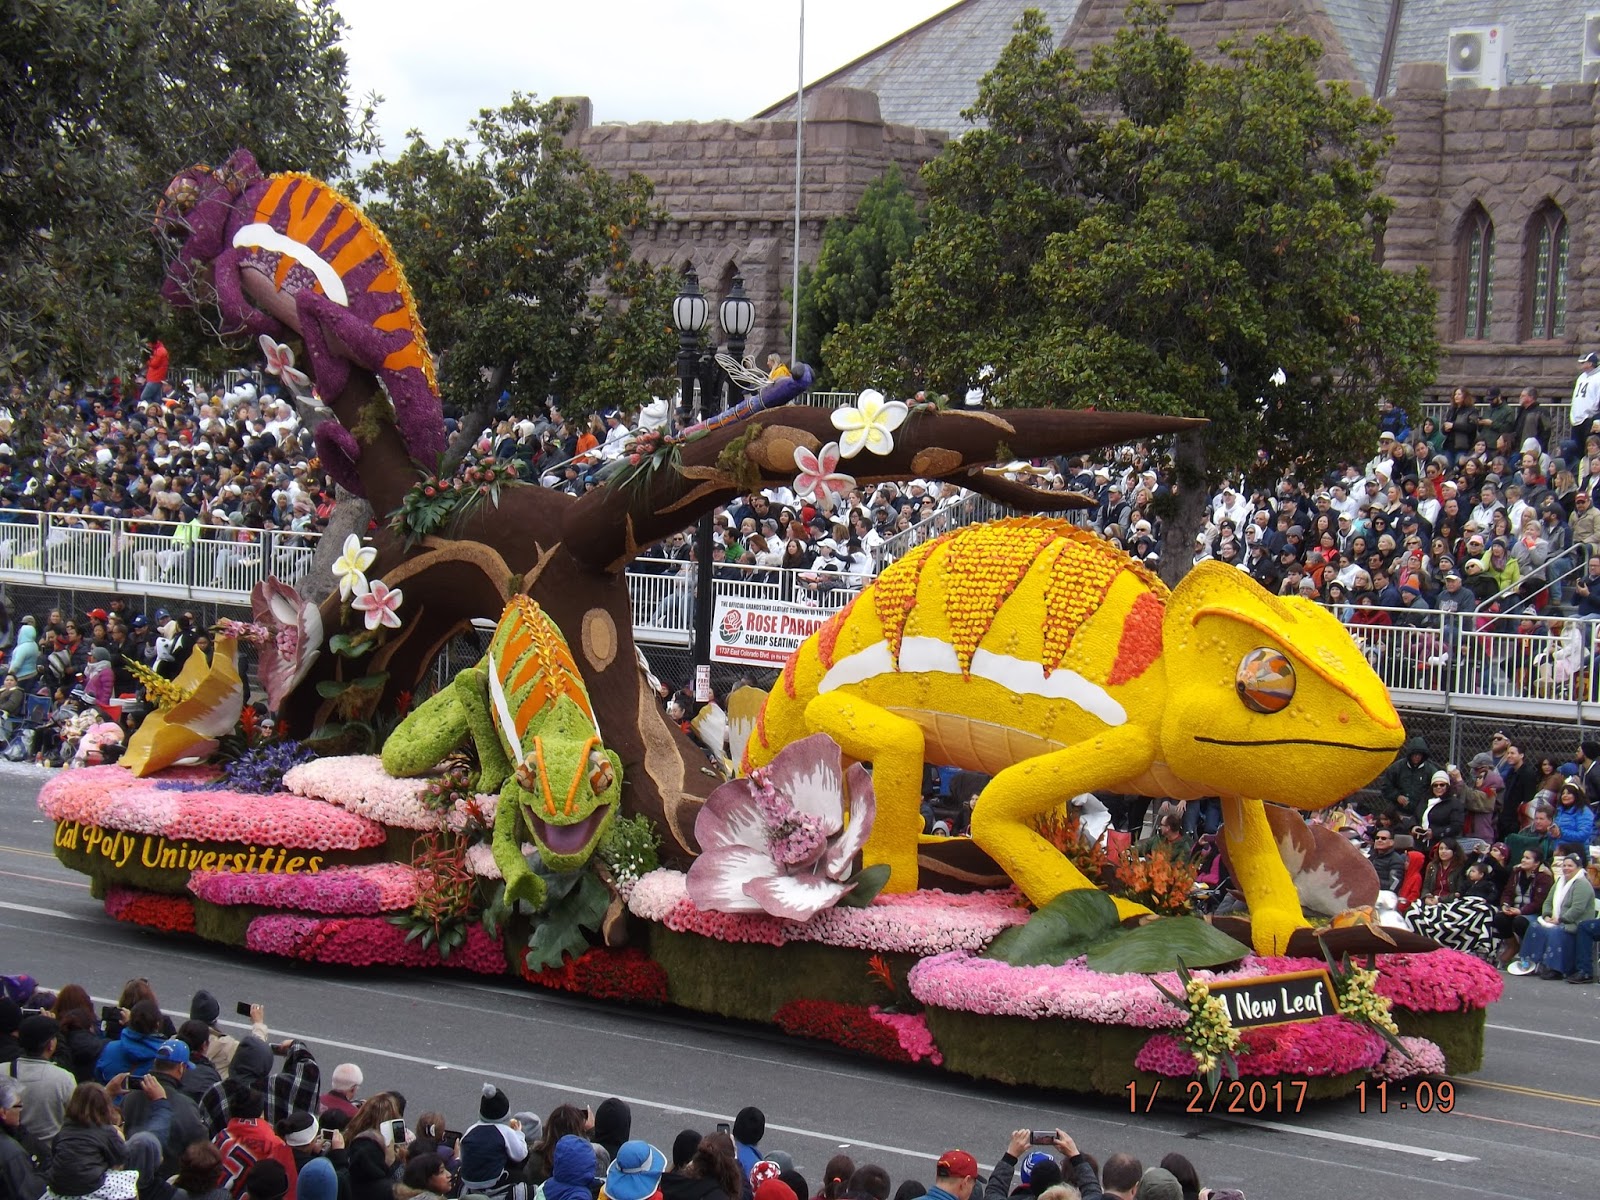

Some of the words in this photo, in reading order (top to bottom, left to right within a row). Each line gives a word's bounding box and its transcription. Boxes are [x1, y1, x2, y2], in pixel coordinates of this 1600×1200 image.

[1575, 382, 1589, 398] 14
[746, 612, 778, 633] ROSE
[780, 615, 826, 636] PARAD
[745, 634, 768, 646] SHARP
[769, 637, 799, 649] SEATING
[741, 650, 759, 658] Colorado
[55, 819, 79, 850] Cal
[83, 825, 136, 868] Poly
[141, 837, 325, 875] Universities
[1235, 991, 1277, 1021] New
[1280, 981, 1324, 1016] Leaf
